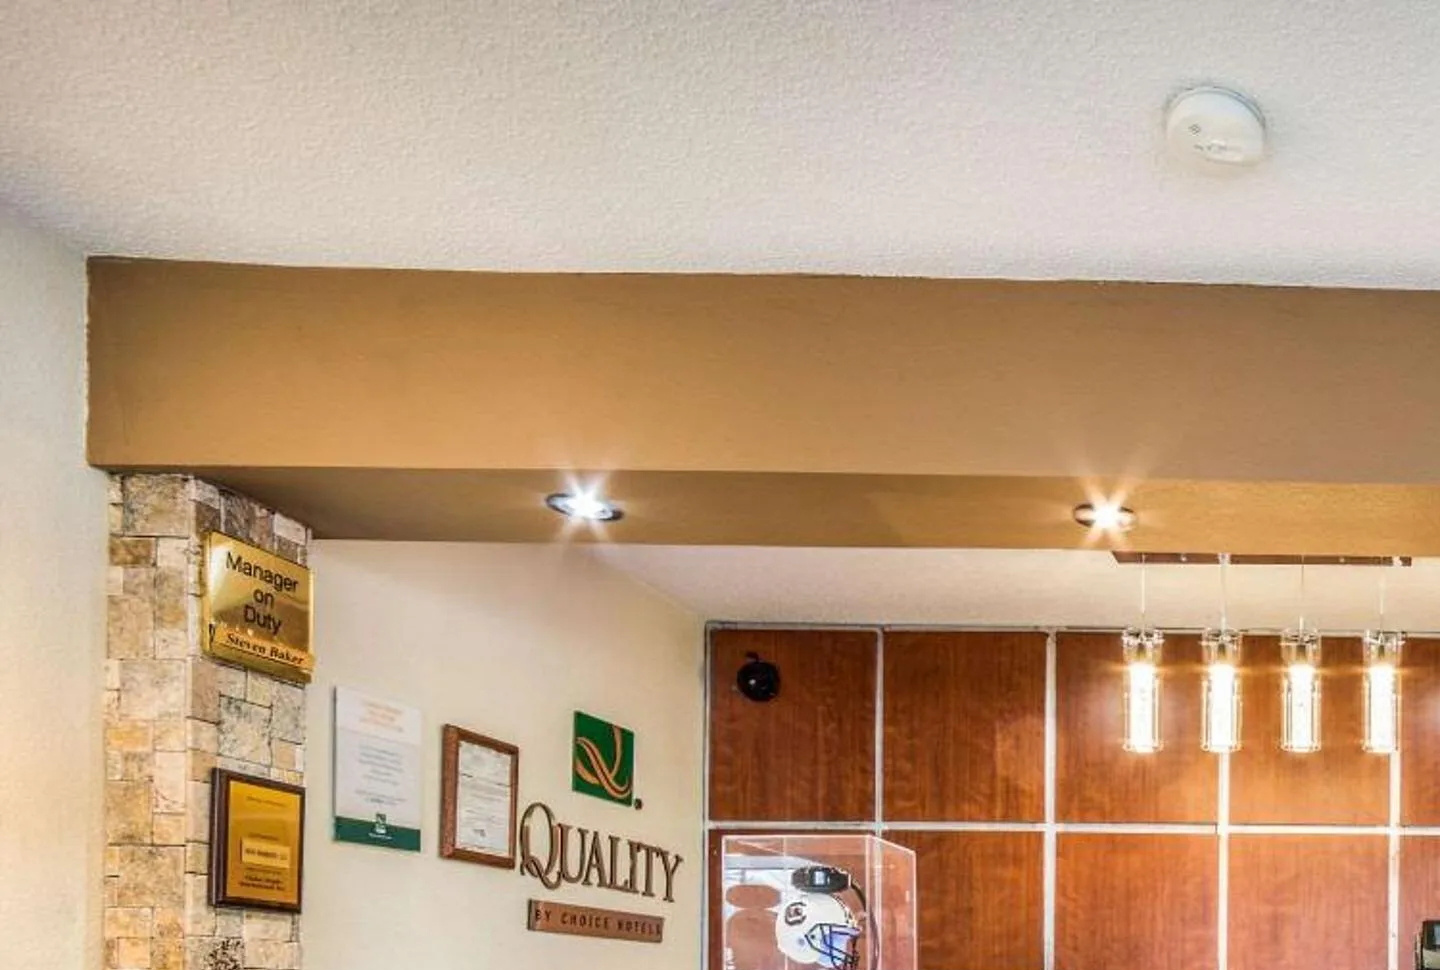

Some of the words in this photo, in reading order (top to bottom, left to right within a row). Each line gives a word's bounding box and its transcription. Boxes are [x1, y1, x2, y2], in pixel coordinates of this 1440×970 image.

[226, 551, 299, 592] Manager
[253, 588, 275, 609] on
[243, 604, 282, 636] Duty
[226, 632, 266, 654] Steven
[269, 645, 305, 664] Baker
[519, 802, 684, 903] QUALITY
[534, 908, 552, 921] BY
[560, 911, 610, 931] CHOICE
[617, 916, 663, 937] HOTELS
